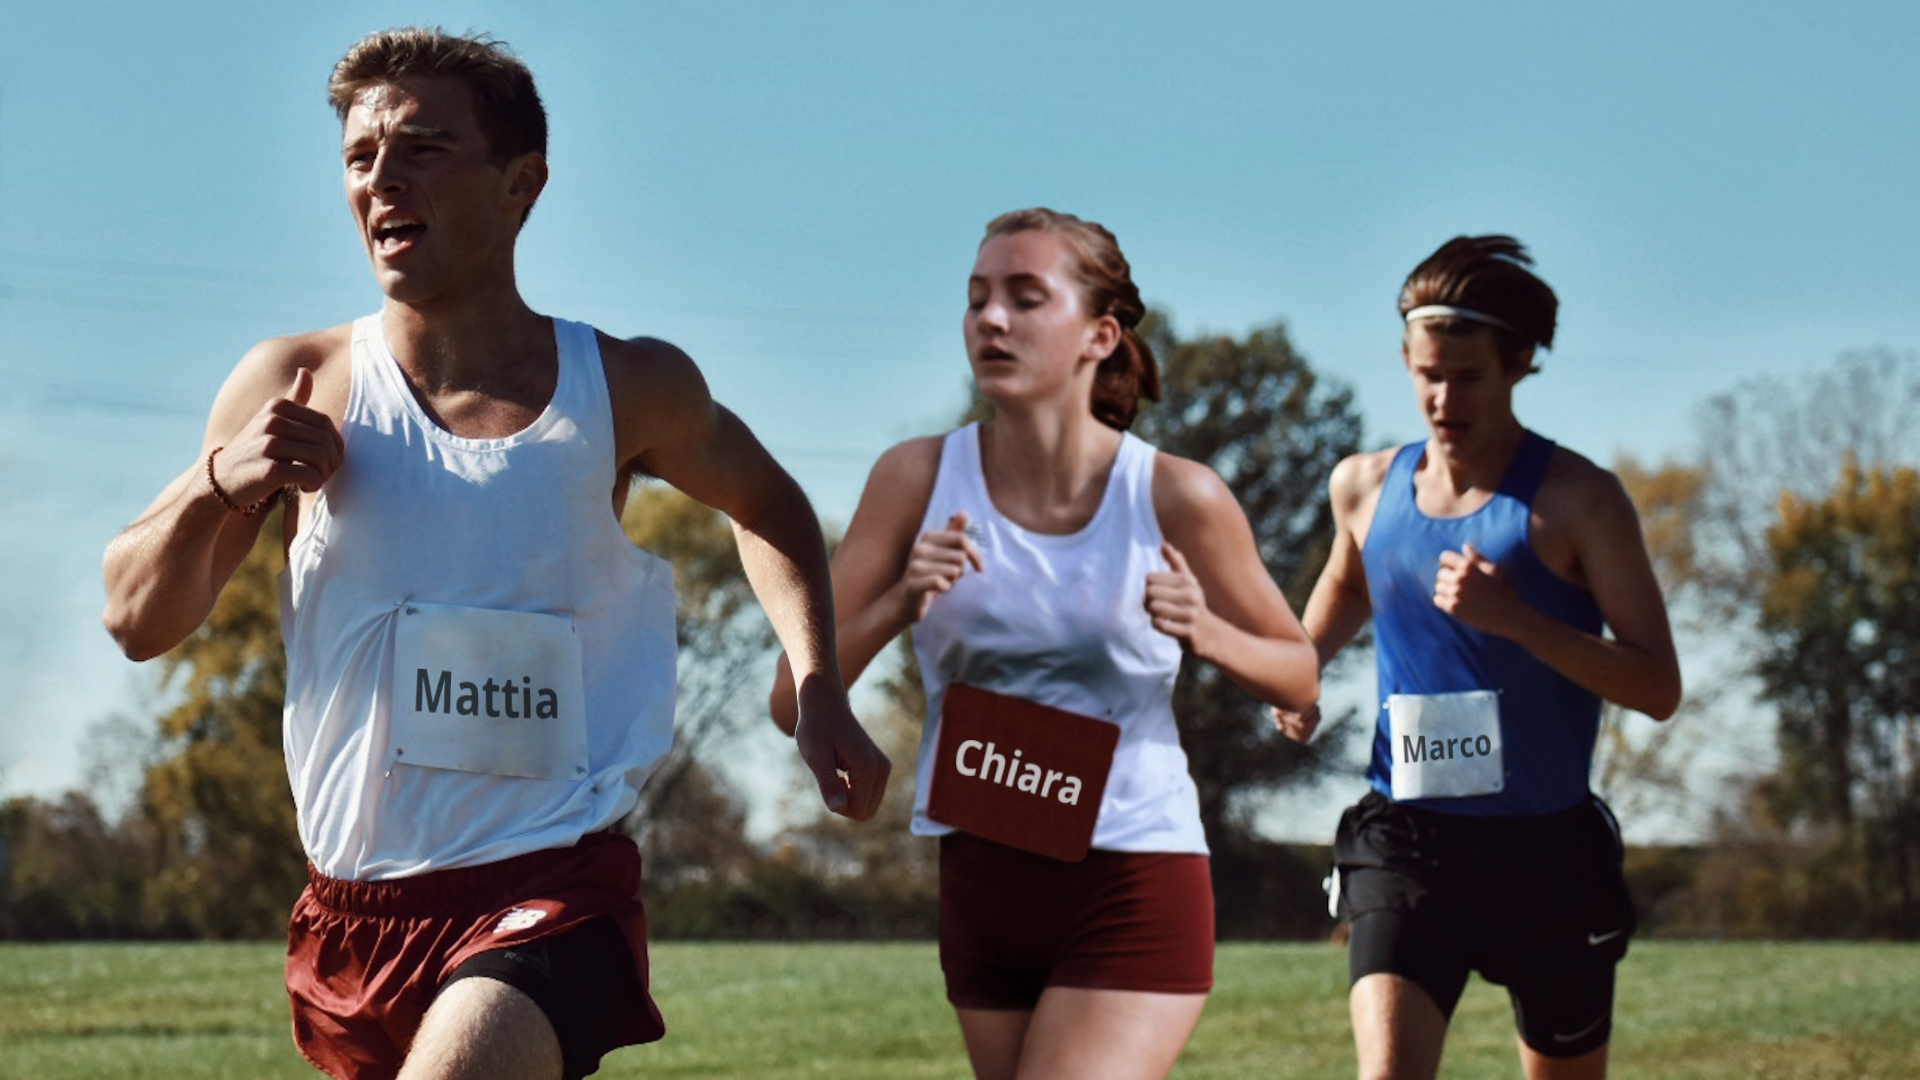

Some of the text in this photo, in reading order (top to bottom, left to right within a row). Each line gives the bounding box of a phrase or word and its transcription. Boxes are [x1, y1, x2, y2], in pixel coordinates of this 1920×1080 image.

[415, 668, 558, 719] Mattia
[955, 739, 1082, 806] Chiara
[1402, 734, 1491, 764] Marco
